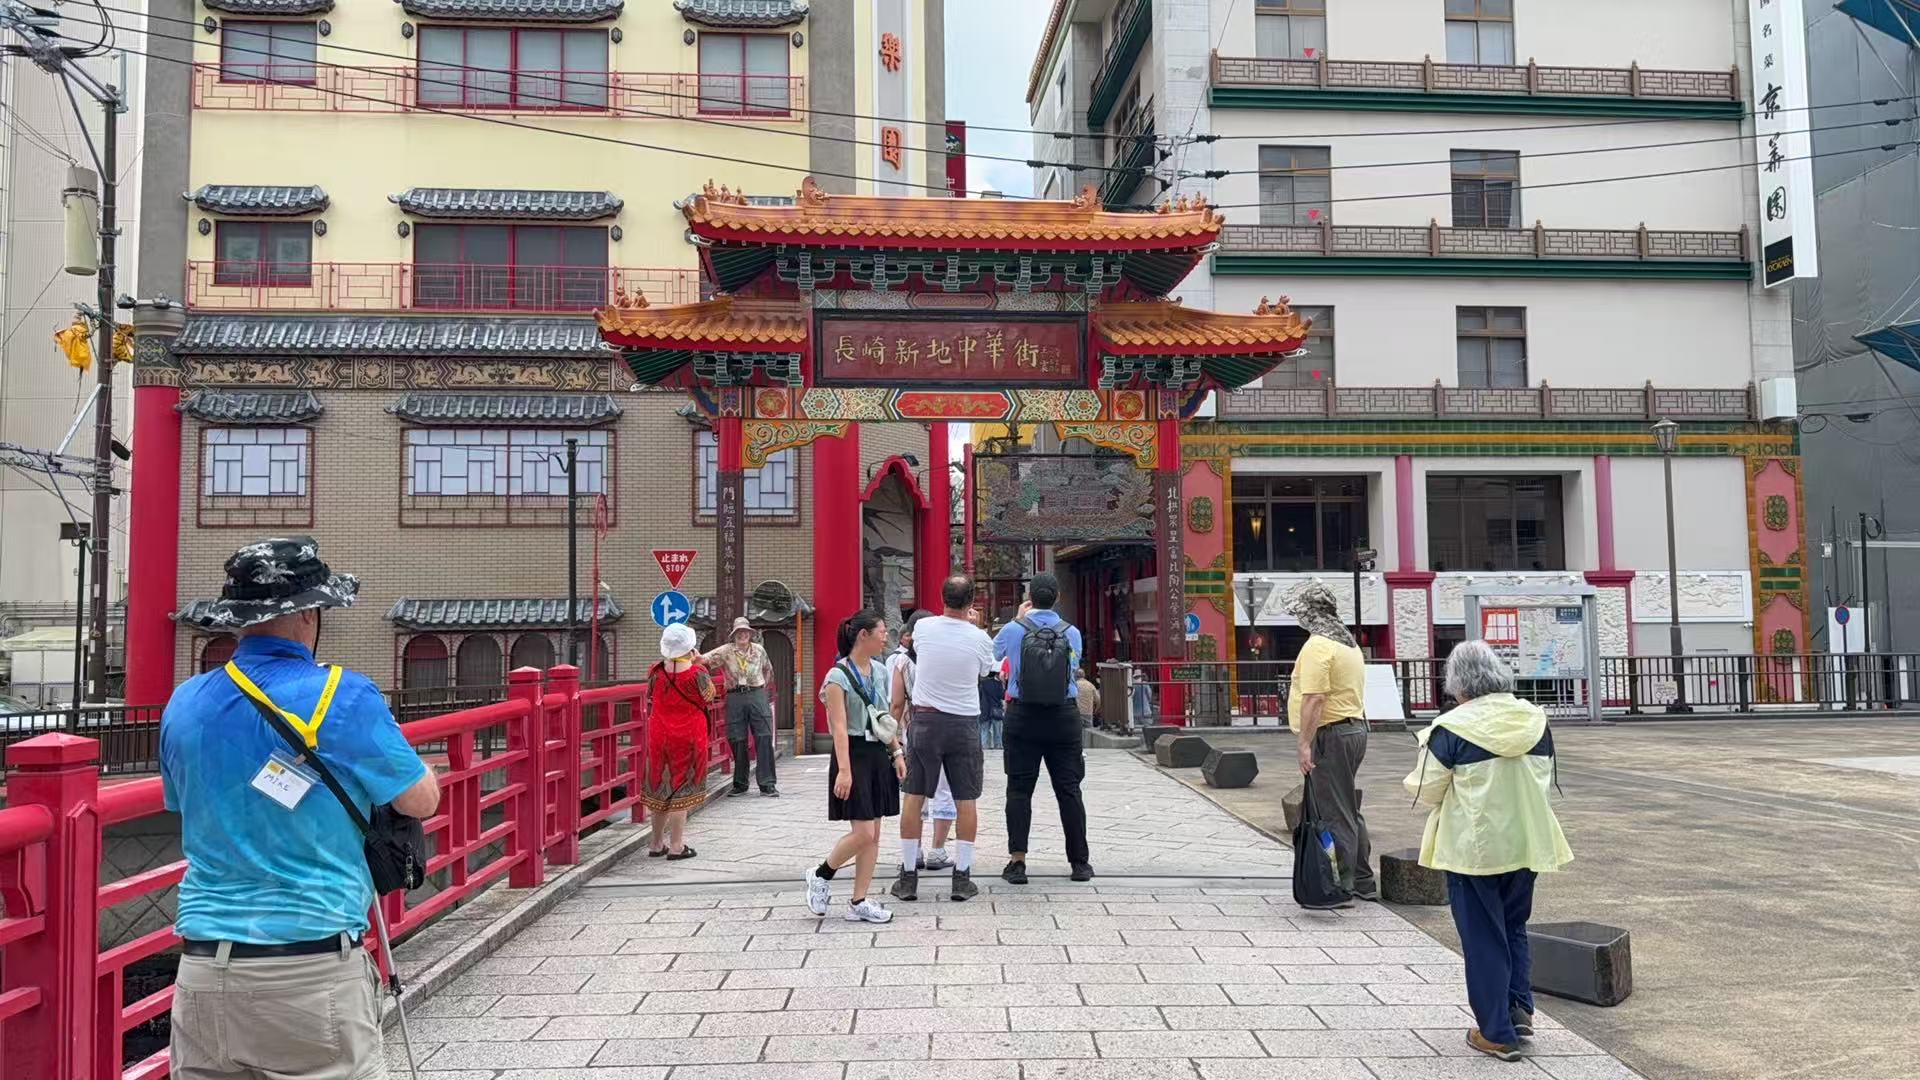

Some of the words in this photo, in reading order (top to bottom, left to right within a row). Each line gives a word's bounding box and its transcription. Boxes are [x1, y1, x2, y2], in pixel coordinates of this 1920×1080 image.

[834, 331, 1040, 369] 長崎新地中華街
[660, 554, 689, 563] 止まれ
[665, 564, 686, 573] STOP
[264, 774, 290, 792] MIKE
